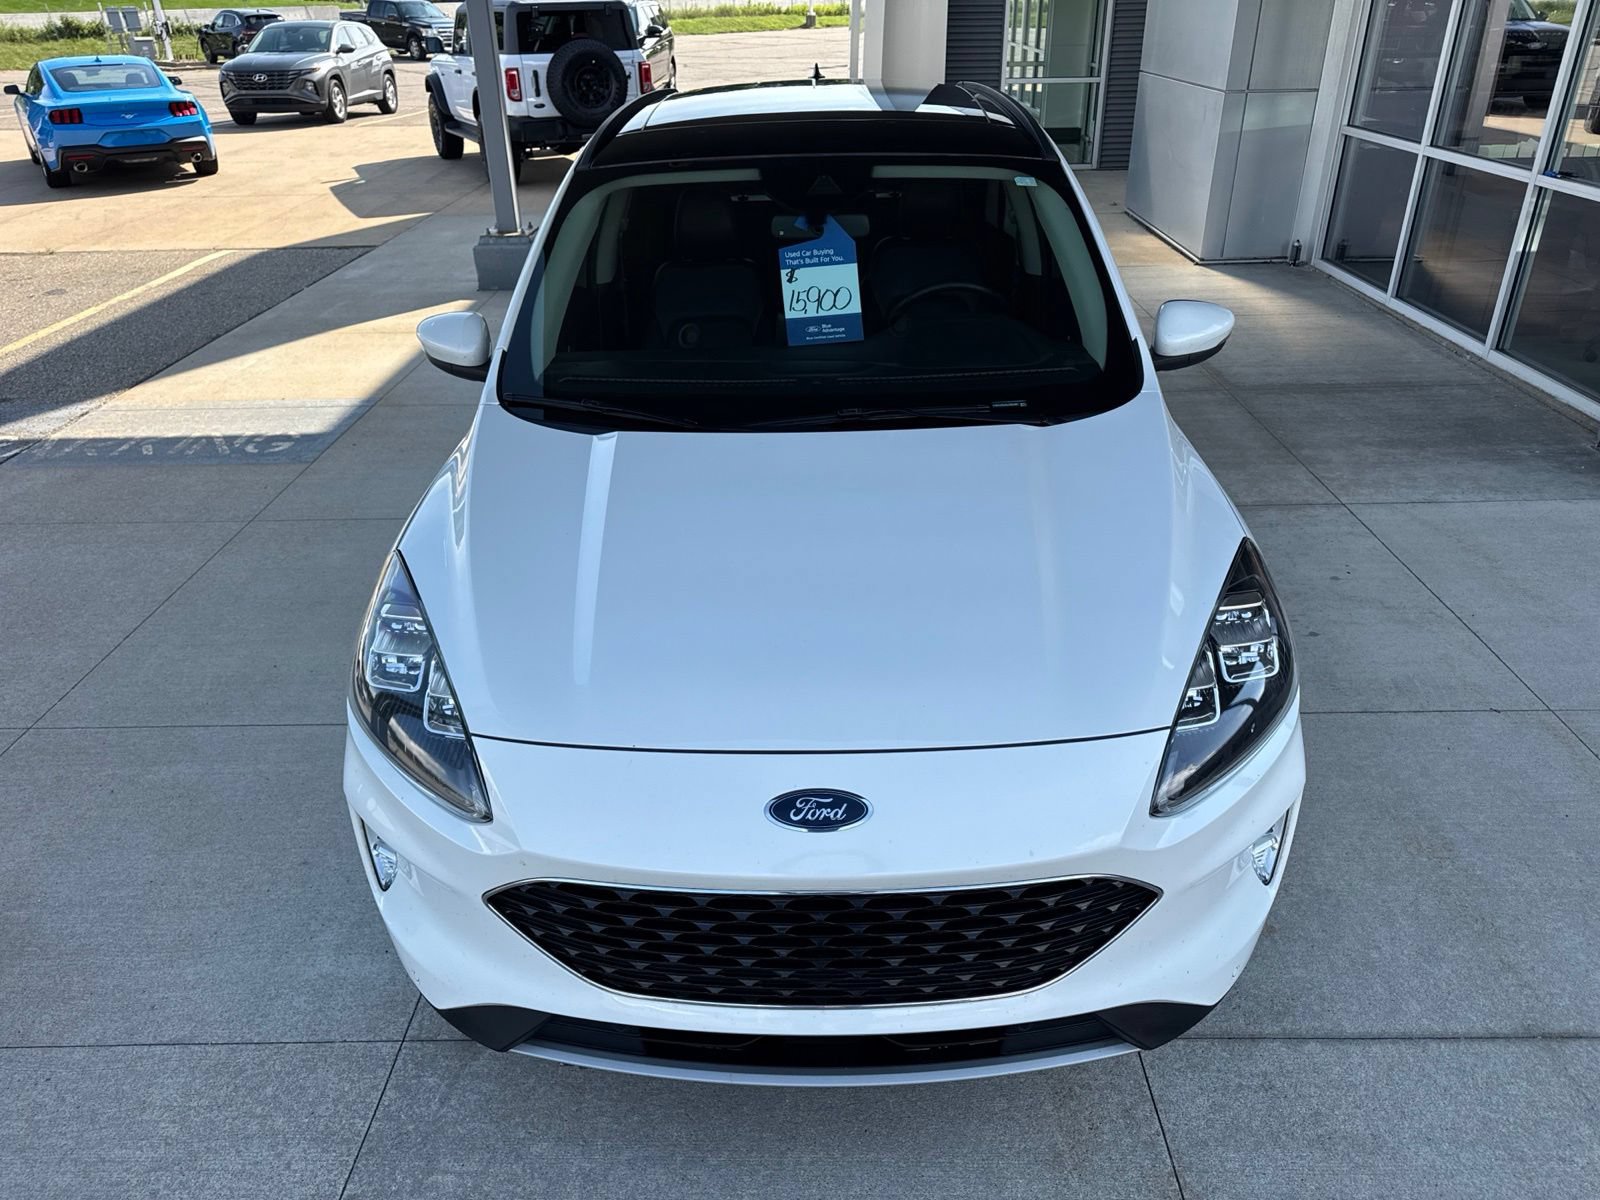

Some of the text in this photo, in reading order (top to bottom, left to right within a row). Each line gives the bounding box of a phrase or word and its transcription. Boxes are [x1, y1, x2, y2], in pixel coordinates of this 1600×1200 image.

[813, 248, 833, 256] Buying
[786, 254, 844, 266] That's Built For You.
[785, 268, 798, 283] $
[789, 286, 852, 314] 15,900
[790, 796, 848, 821] Ford
